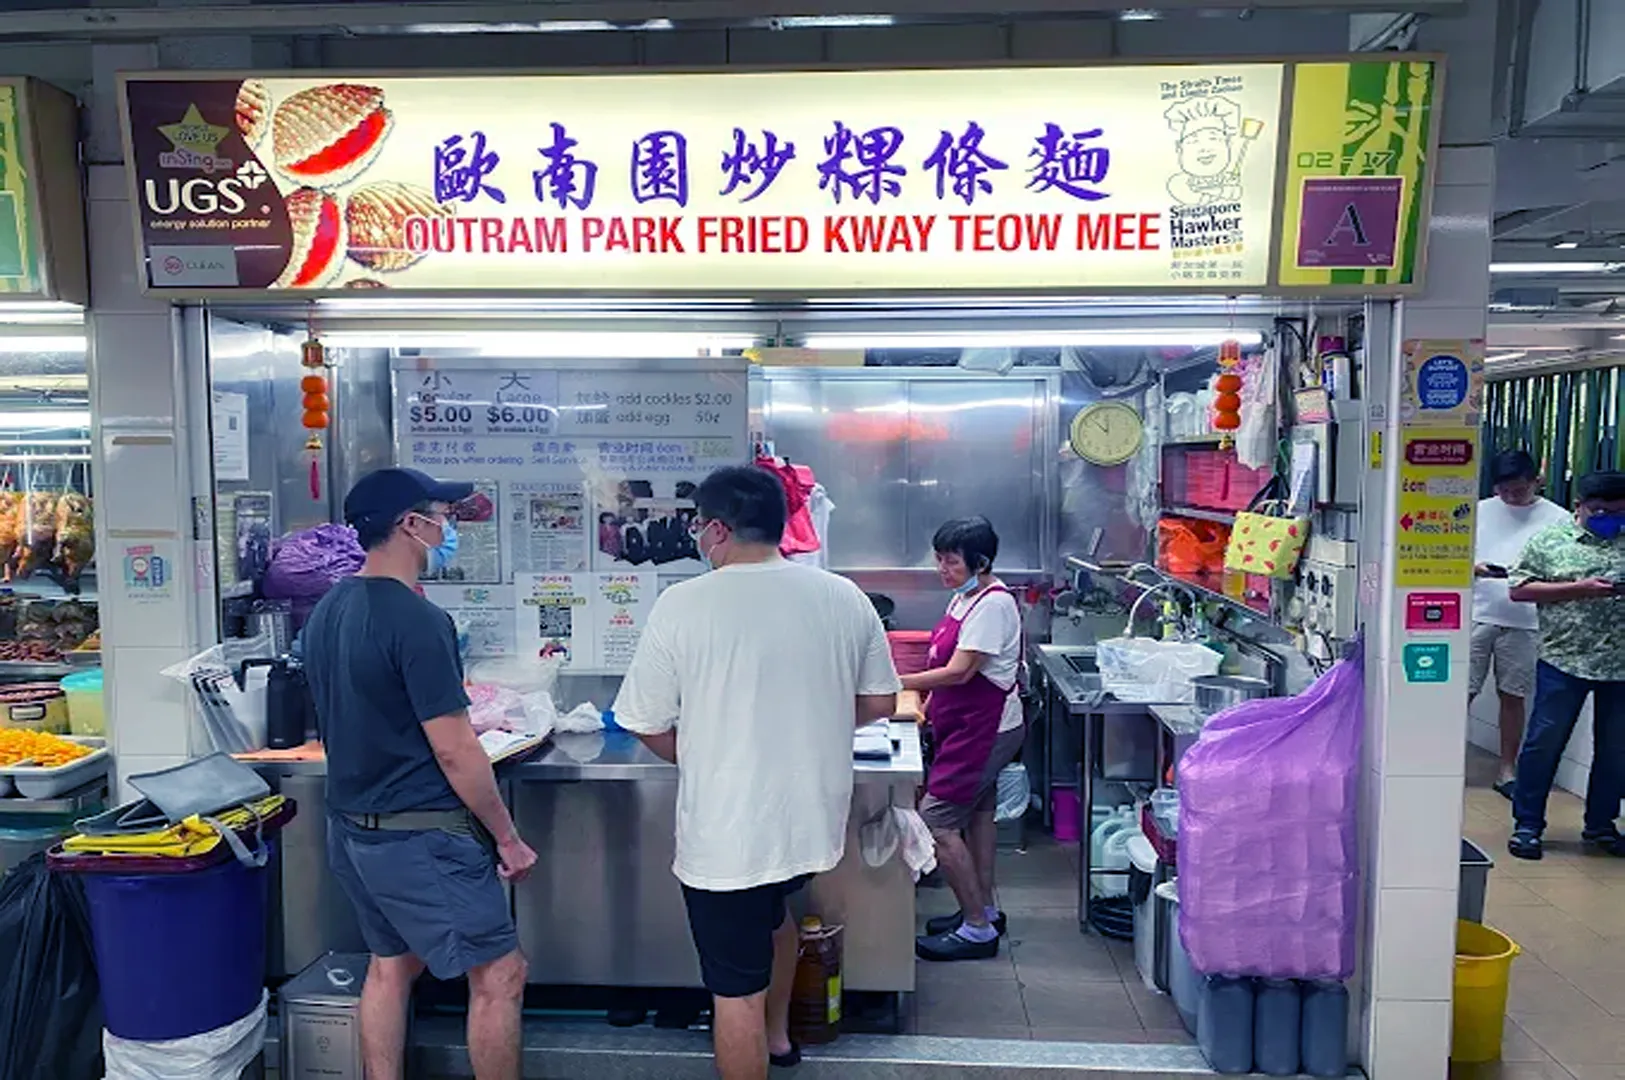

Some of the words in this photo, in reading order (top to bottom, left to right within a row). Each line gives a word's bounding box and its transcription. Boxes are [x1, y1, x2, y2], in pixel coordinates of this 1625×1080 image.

[1297, 151, 1334, 168] 02
[145, 179, 247, 214] UGS
[1170, 203, 1241, 218] Singapore
[150, 220, 187, 230] energy
[190, 219, 230, 229] solution
[231, 218, 271, 230] partner
[1170, 215, 1242, 235] Hawker
[1321, 201, 1371, 246] A
[404, 217, 568, 253] OUTRAM
[582, 217, 685, 253] PARK
[697, 217, 809, 253] FRIED
[824, 216, 936, 252] KWAY
[949, 215, 1063, 252] TEOW
[1076, 213, 1161, 251] MEE
[1171, 235, 1231, 249] Masters
[422, 371, 452, 390] 小
[499, 371, 531, 391] 大
[617, 392, 641, 406] add
[644, 392, 690, 406] cockles
[694, 391, 732, 406] $2.00
[409, 406, 472, 423] $5.00
[487, 406, 550, 424] $6.00
[616, 411, 641, 422] add
[644, 413, 670, 426] egg
[413, 455, 442, 465] Please
[444, 457, 460, 466] pay
[462, 456, 486, 465] when
[488, 455, 525, 466] ordering
[532, 455, 550, 465] Self
